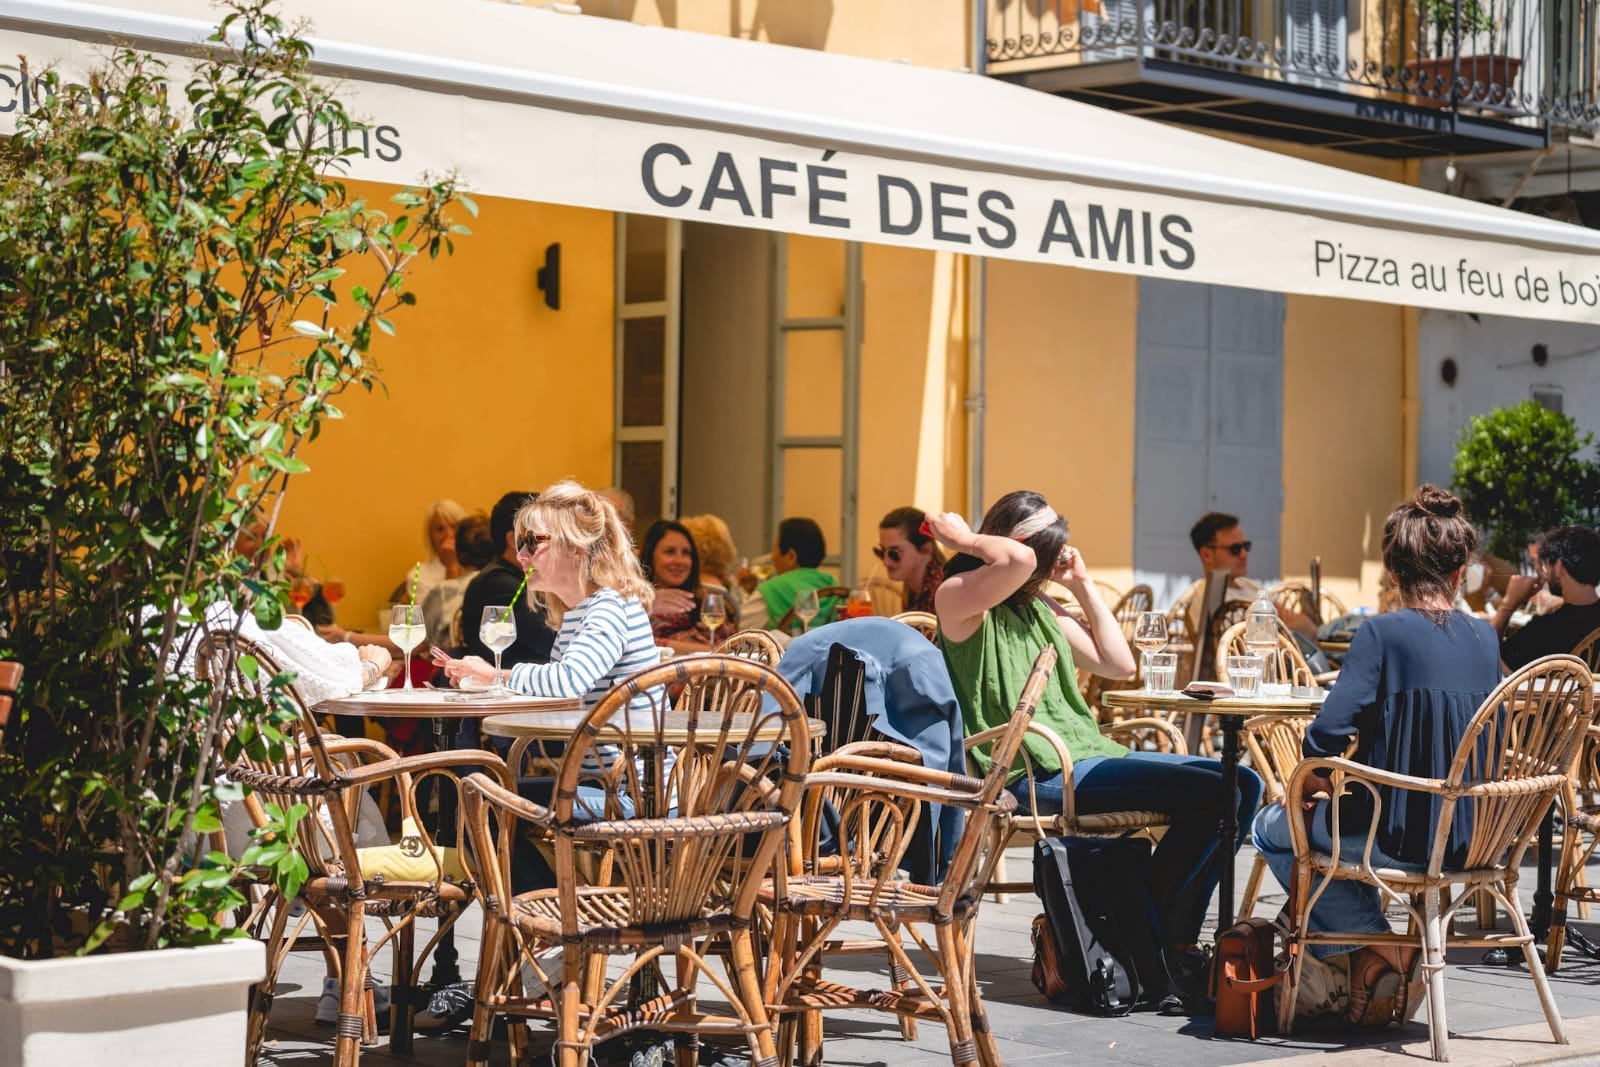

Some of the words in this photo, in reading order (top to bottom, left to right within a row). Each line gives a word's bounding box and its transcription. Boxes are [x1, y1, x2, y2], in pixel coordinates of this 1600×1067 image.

[641, 142, 850, 228] CAFÉ
[877, 174, 1017, 249] DES
[1038, 199, 1196, 270] AMIS
[1314, 239, 1400, 287] Pizza
[1411, 262, 1447, 292] au
[1456, 258, 1505, 298] feu
[1514, 266, 1549, 304] de
[1558, 270, 1600, 307] bo
